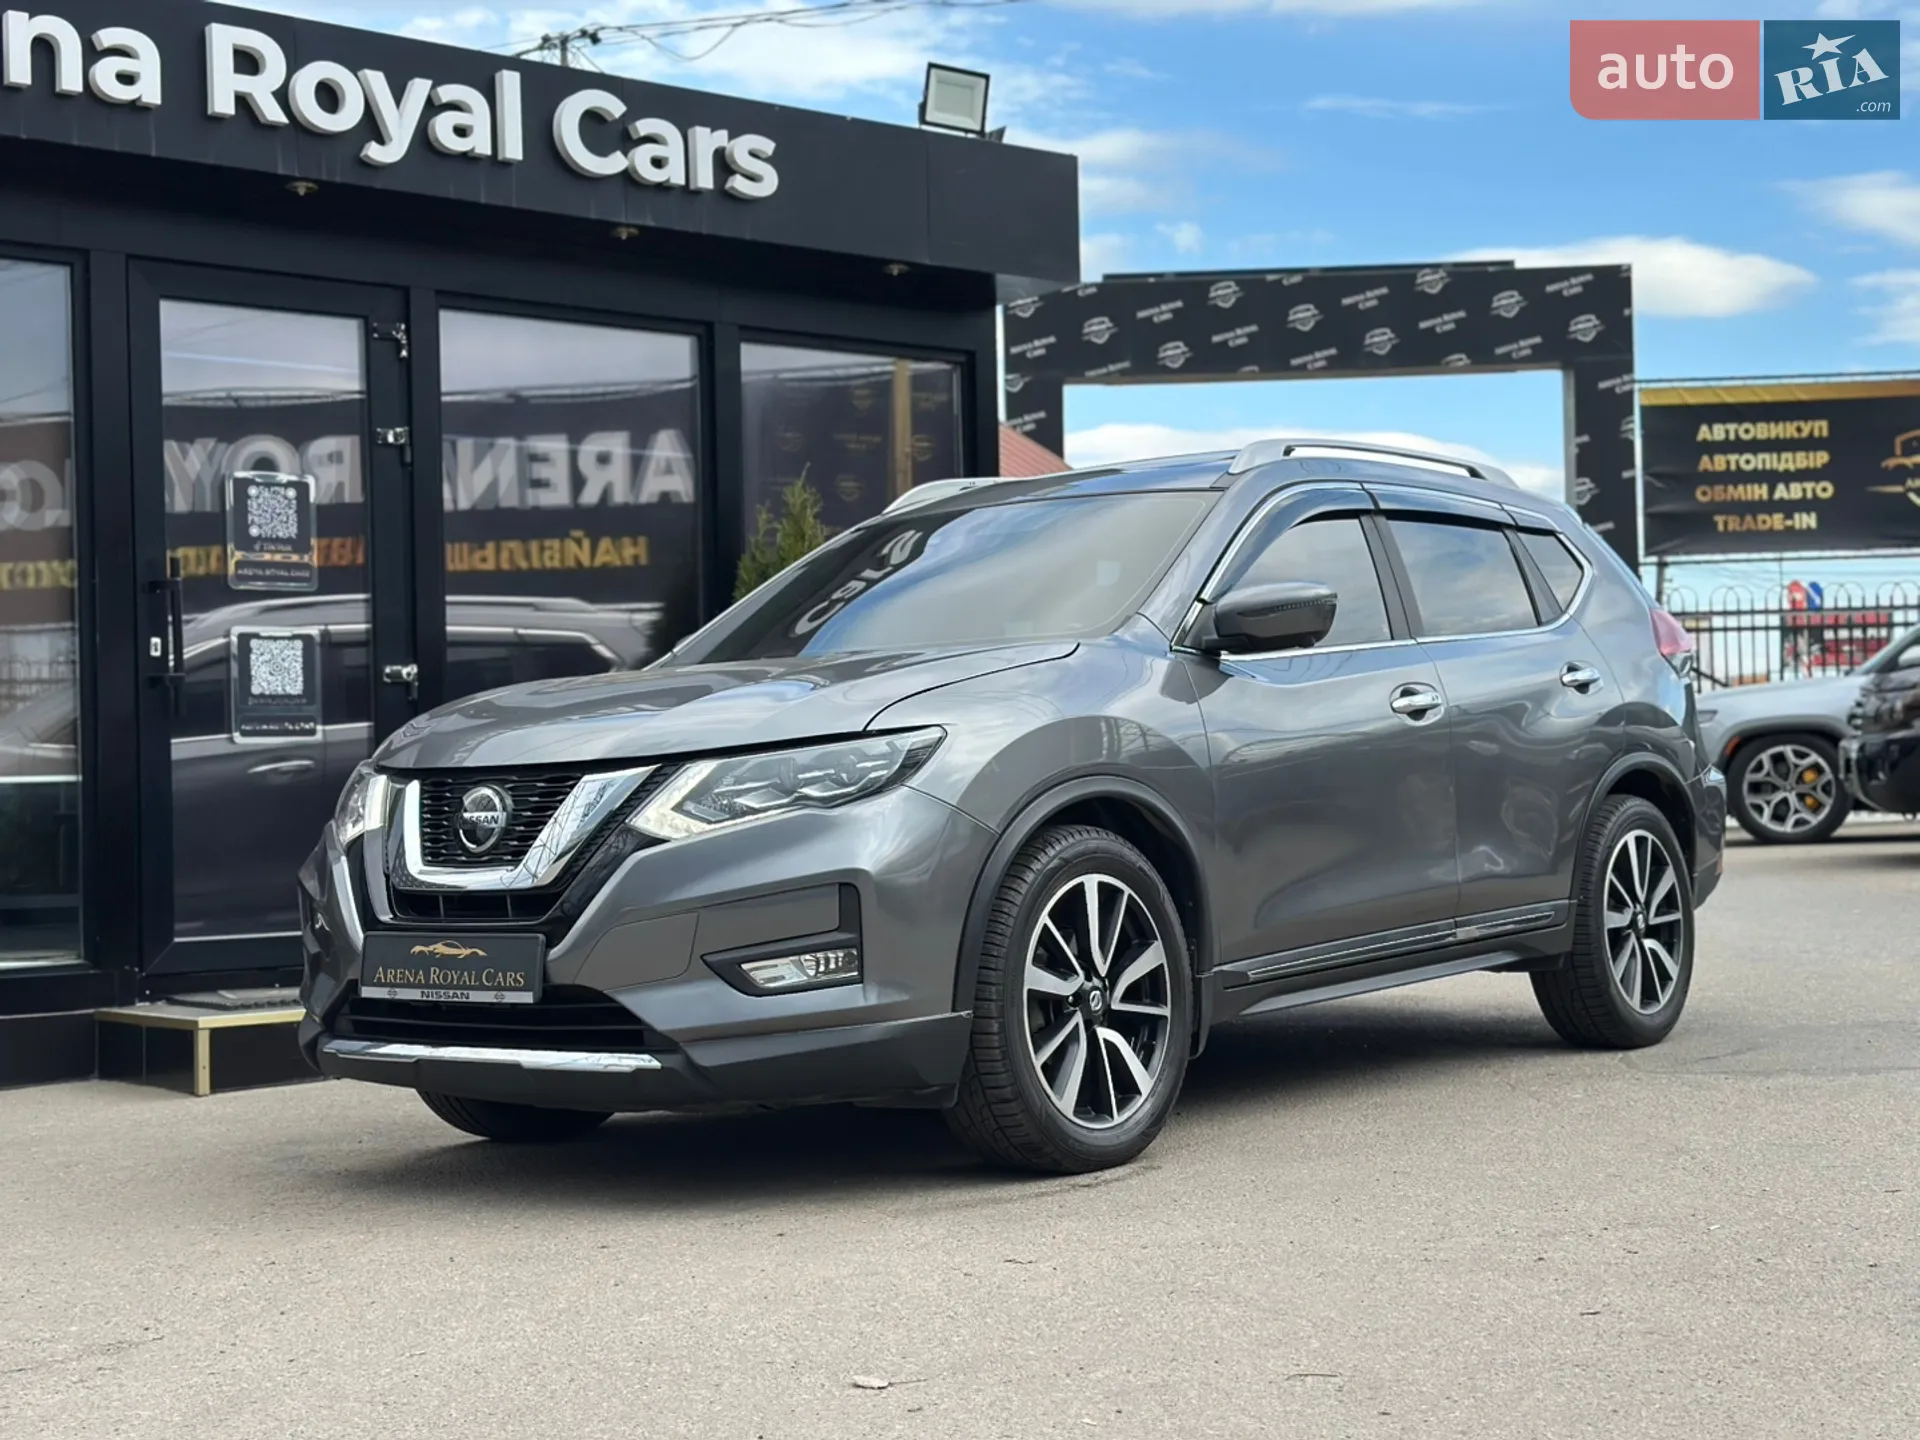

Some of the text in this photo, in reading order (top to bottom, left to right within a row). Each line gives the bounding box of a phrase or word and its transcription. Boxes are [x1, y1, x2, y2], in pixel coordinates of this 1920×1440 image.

[205, 22, 524, 167] Royal
[552, 88, 780, 201] Cars
[1696, 419, 1829, 442] АВТОВИКУП
[1697, 450, 1830, 473] АВТОПІДБІР
[1695, 481, 1835, 503] ОБМІН АВТО
[1714, 511, 1818, 532] TRADE-IN
[373, 966, 525, 987] ARENA ROYAL CARS
[420, 990, 470, 1000] NISSAN
